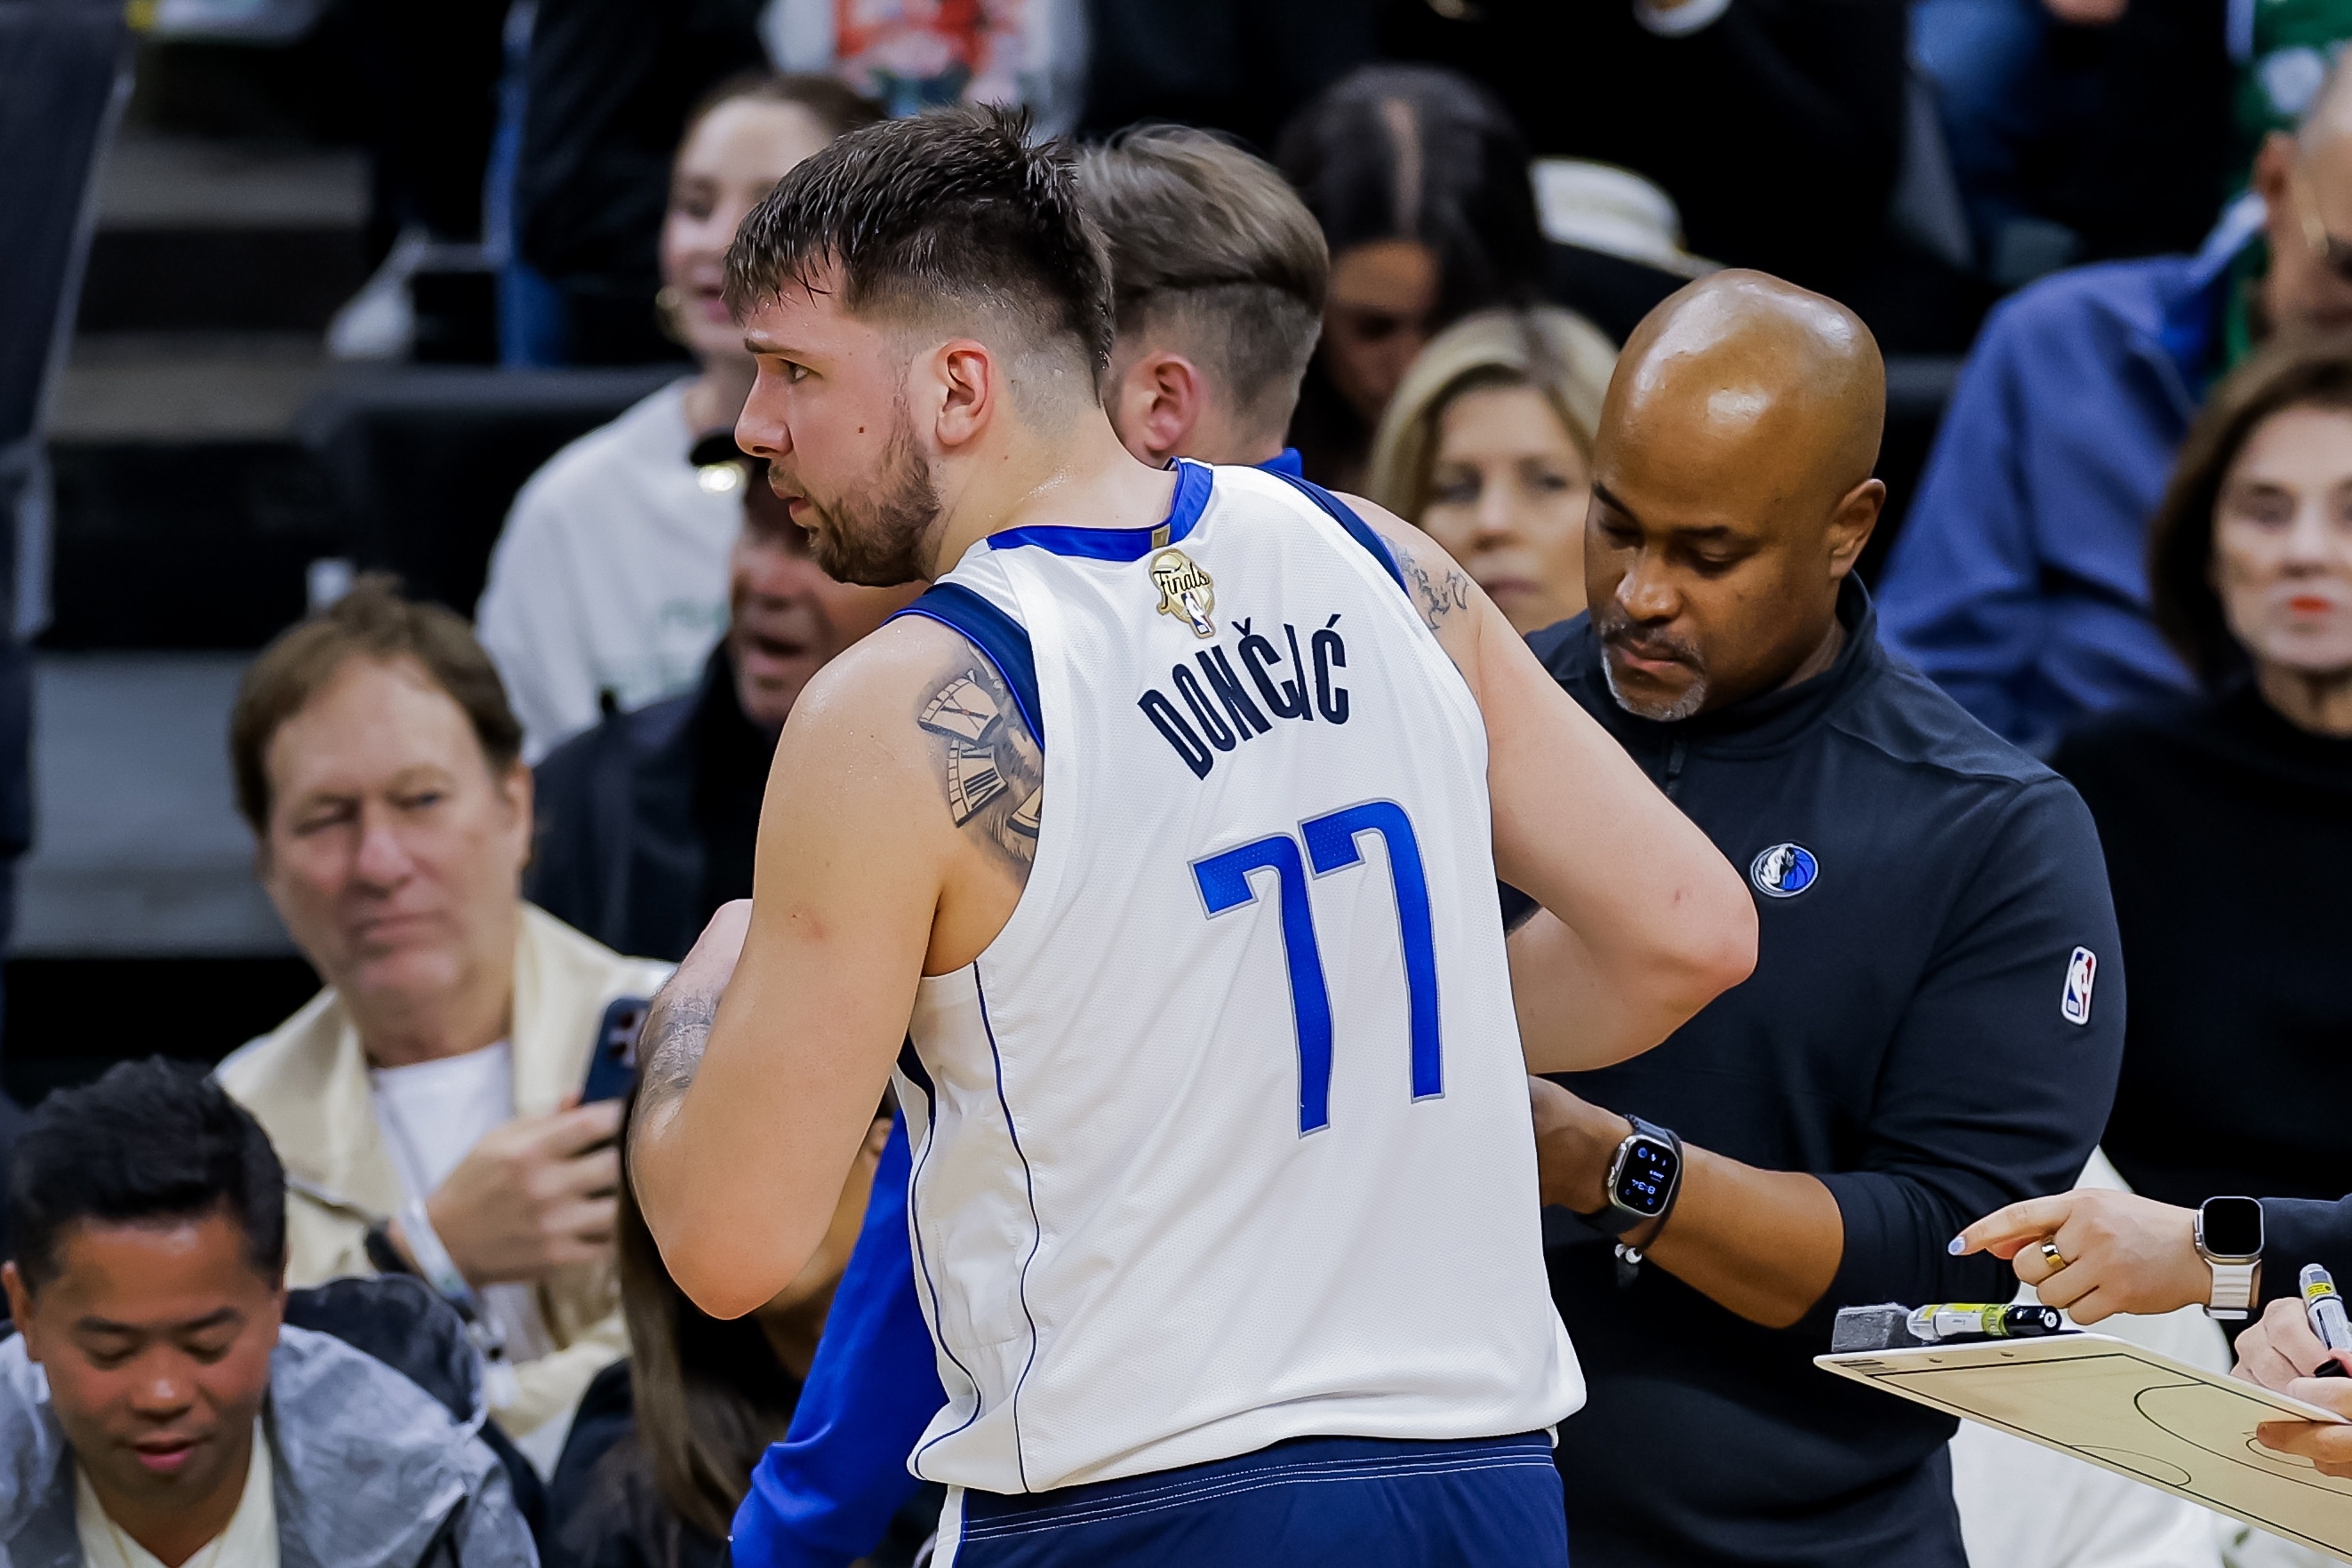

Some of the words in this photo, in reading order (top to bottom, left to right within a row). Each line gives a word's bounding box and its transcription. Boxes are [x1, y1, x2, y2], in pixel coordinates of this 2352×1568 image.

[1152, 560, 1211, 610] Finals
[1137, 613, 1349, 780] DONČIĆ
[1187, 797, 1445, 1139] 77
